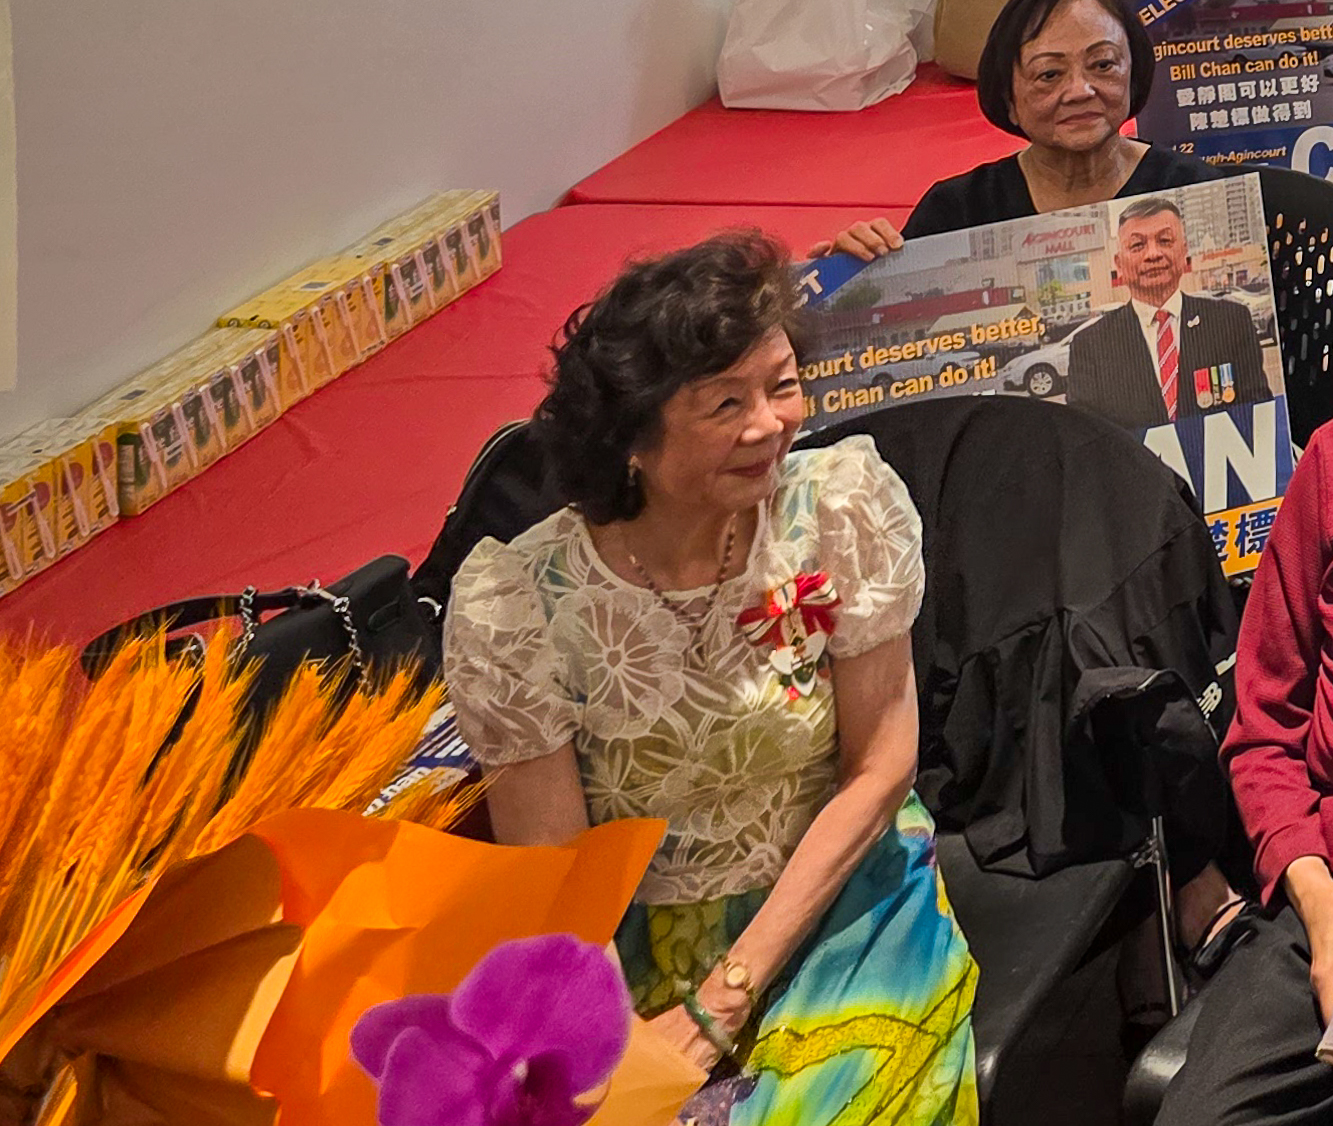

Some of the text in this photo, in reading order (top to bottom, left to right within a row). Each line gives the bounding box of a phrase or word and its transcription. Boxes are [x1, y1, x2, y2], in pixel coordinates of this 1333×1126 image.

[1223, 28, 1296, 51] deserves
[1169, 58, 1275, 82] Bill Chan can
[859, 310, 1045, 371] deserves better,
[822, 380, 886, 415] Chan
